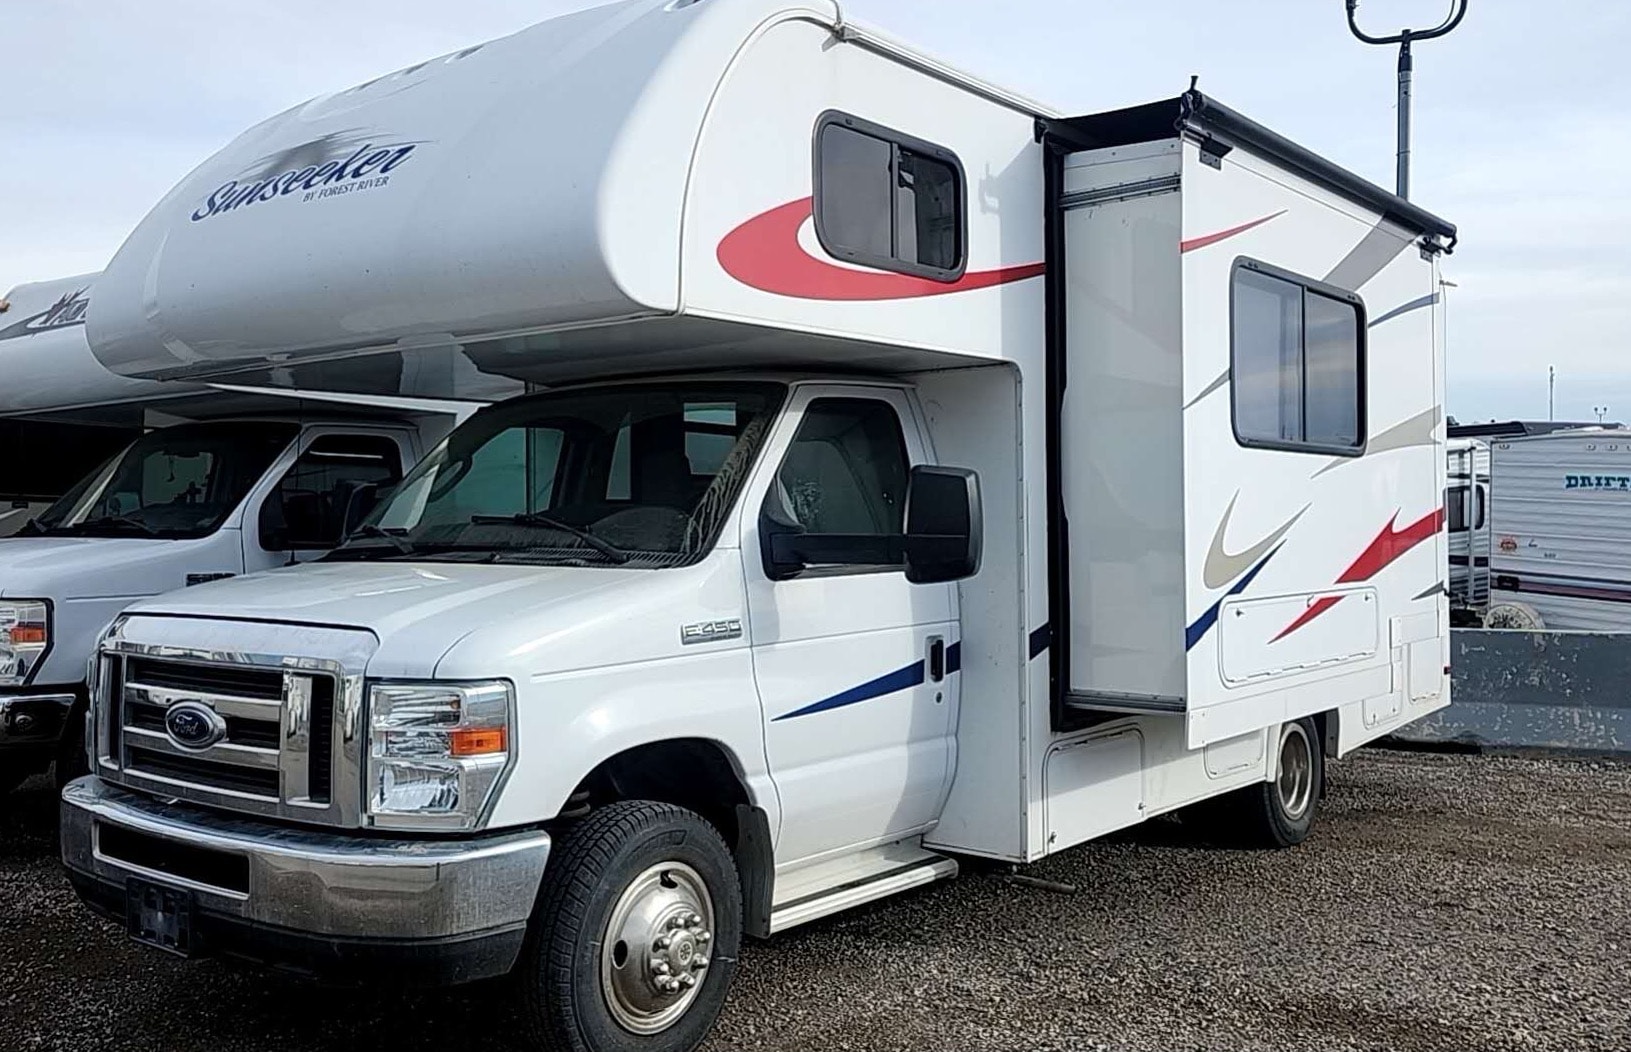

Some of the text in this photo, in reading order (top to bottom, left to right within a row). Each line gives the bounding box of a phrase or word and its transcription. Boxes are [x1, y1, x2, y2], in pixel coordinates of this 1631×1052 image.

[191, 143, 416, 221] Sunseeker
[303, 176, 389, 202] BY FOREST RIVER
[1565, 475, 1631, 488] DRIFT
[173, 714, 200, 735] Ford
